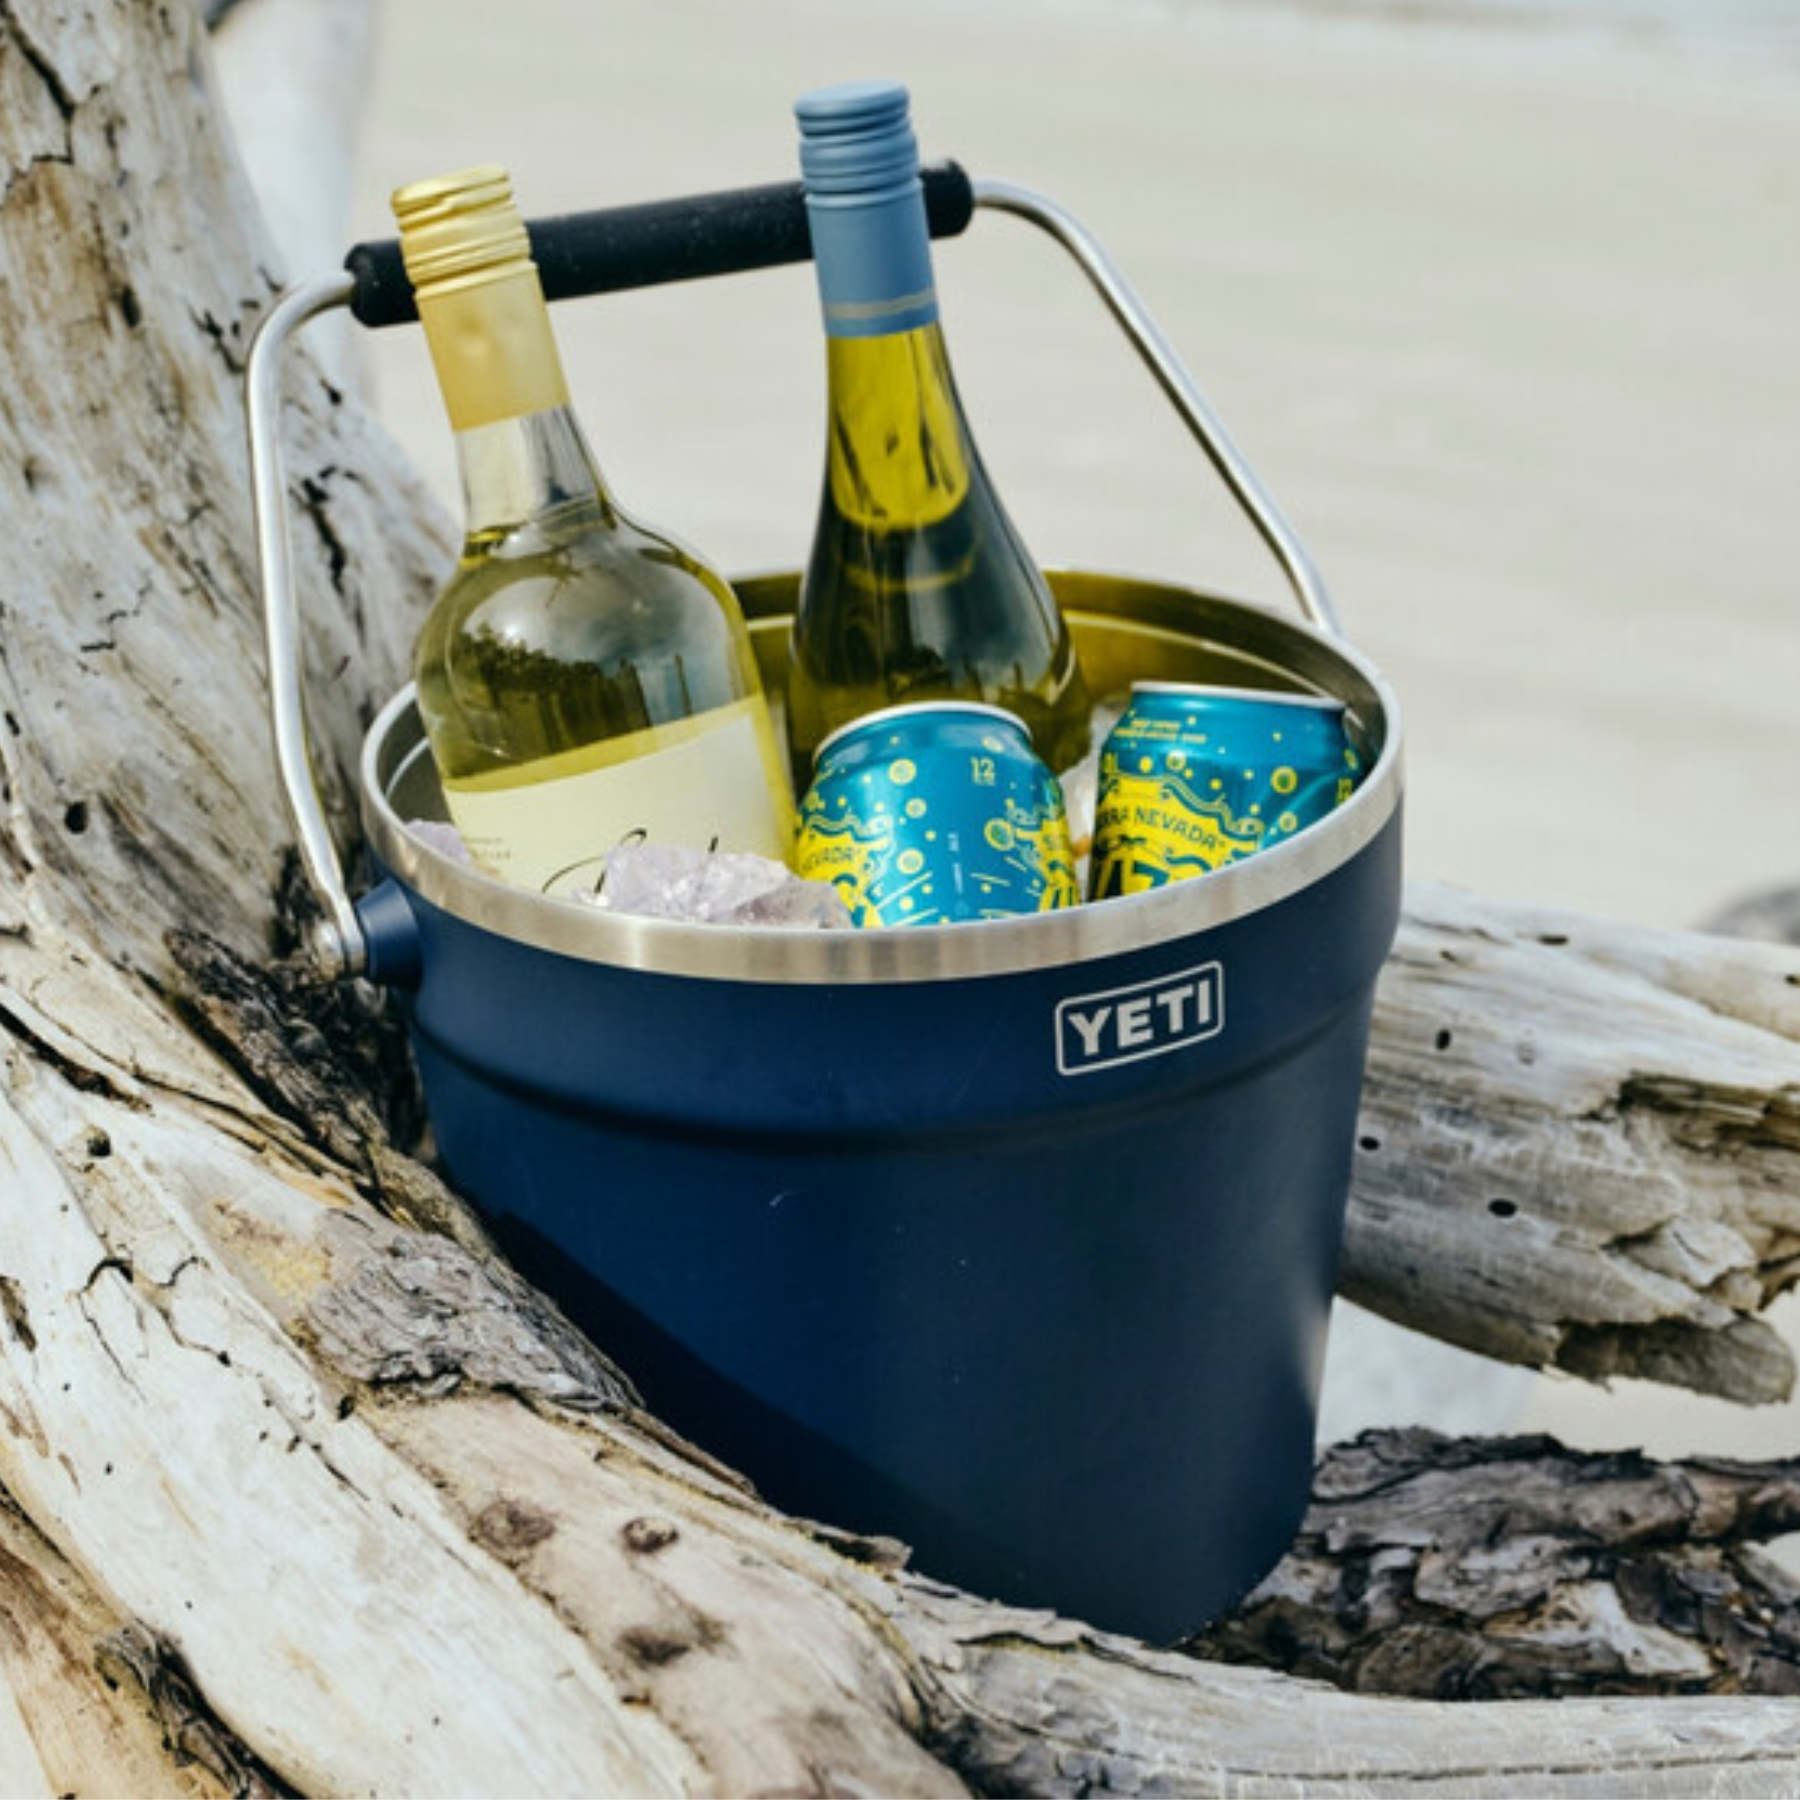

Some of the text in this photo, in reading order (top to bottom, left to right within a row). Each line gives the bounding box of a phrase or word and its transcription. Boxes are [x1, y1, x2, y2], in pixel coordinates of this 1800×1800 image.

[970, 756, 995, 780] 12
[1136, 806, 1219, 848] NEVADA
[1067, 979, 1211, 1057] YETI
